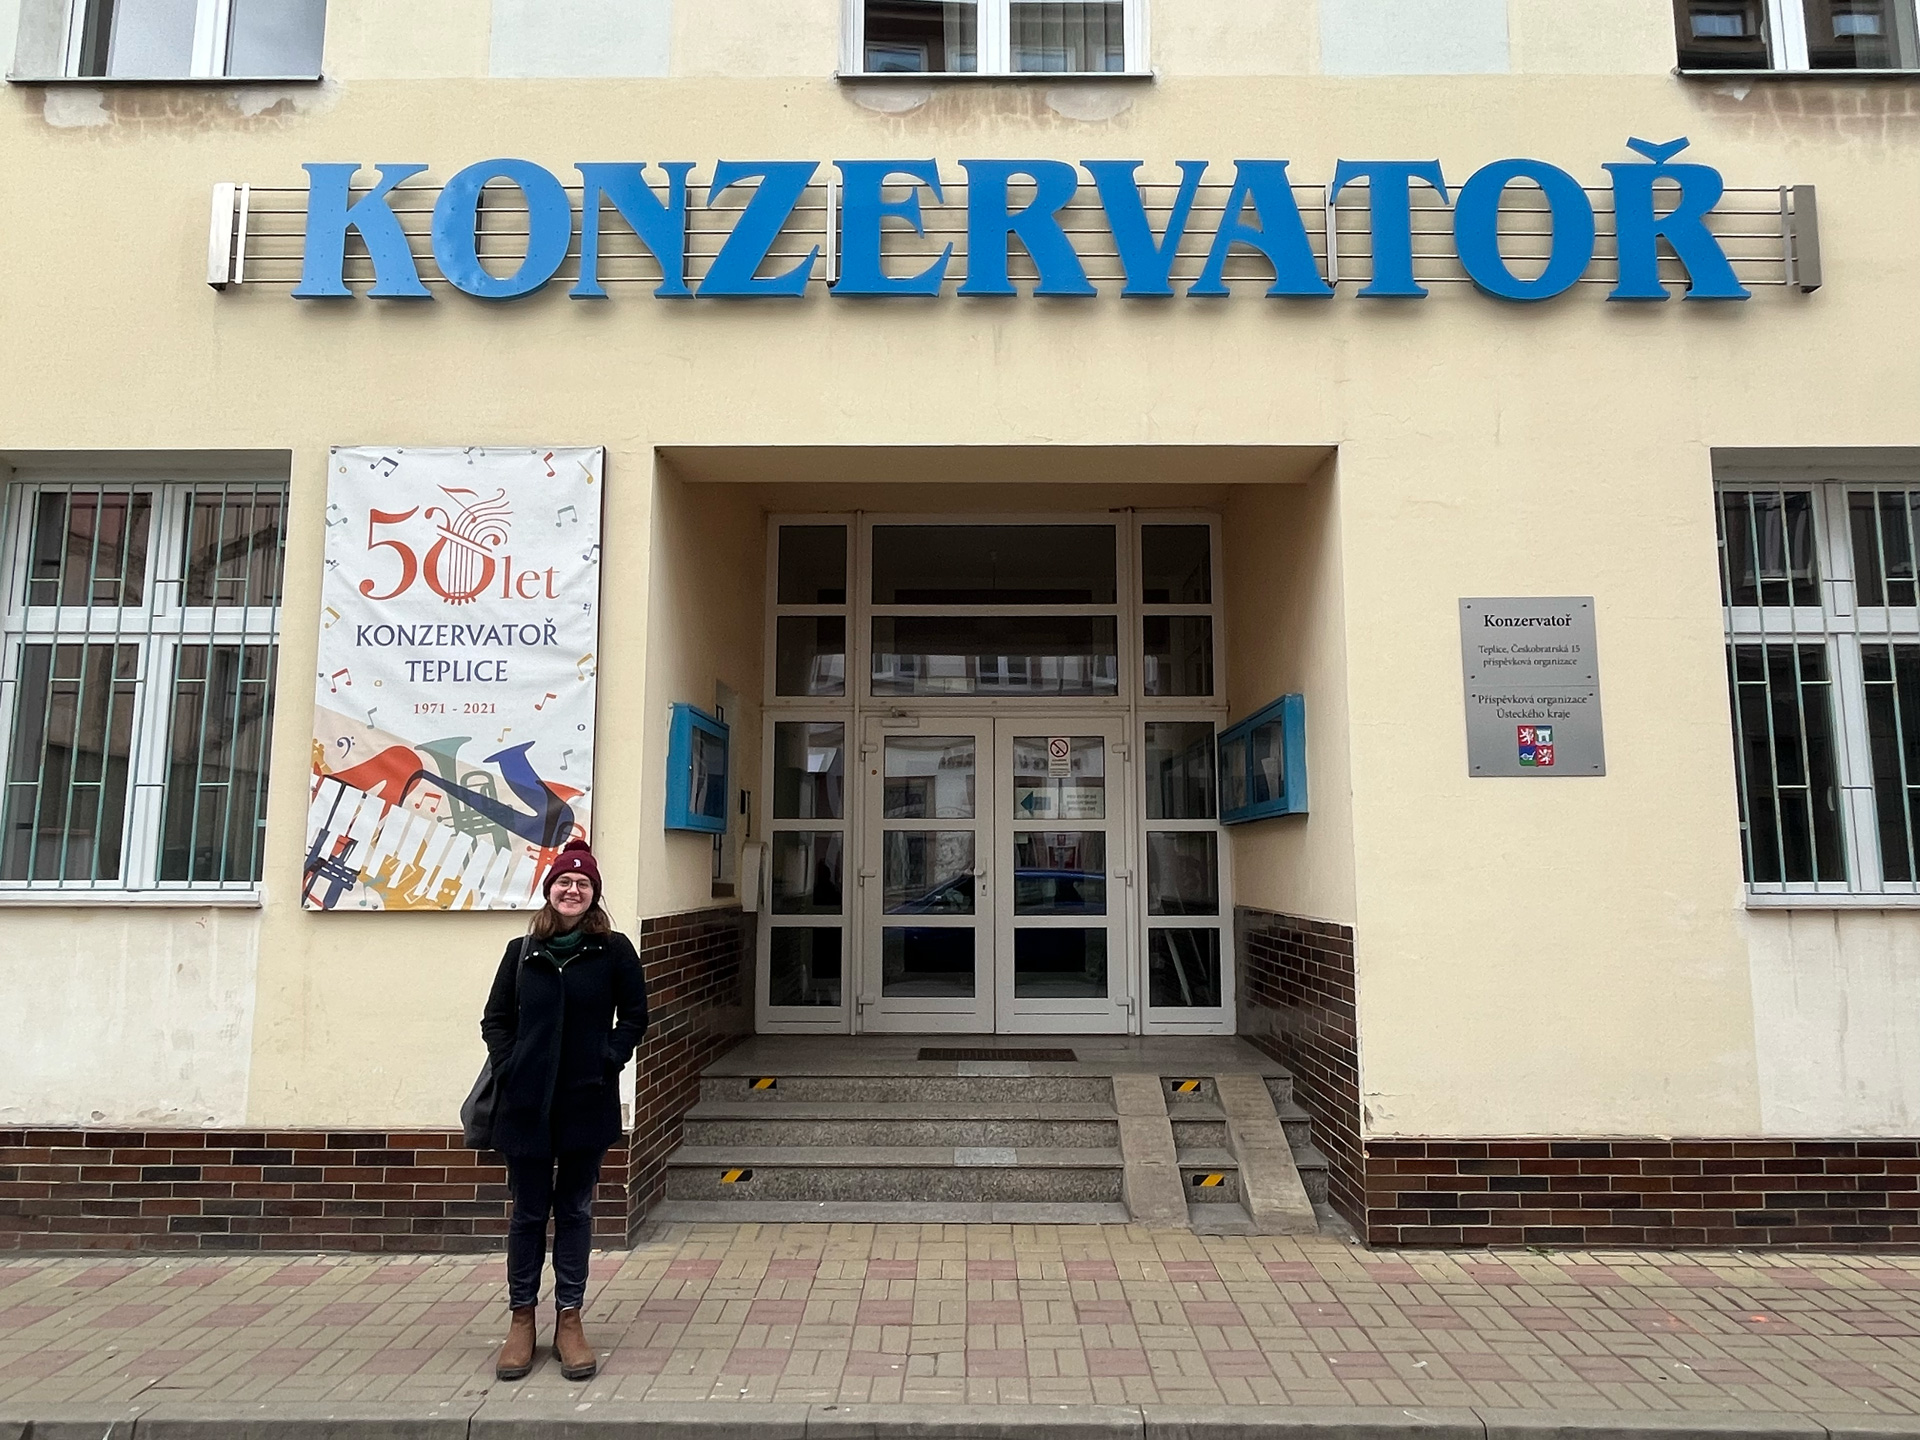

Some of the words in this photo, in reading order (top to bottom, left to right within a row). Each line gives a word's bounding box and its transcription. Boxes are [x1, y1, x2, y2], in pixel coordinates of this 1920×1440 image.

[290, 136, 1751, 308] KONZERVATOŘ
[359, 495, 505, 605] 50
[500, 555, 560, 600] let
[1483, 613, 1572, 627] Konzervatoř
[356, 618, 559, 647] KONZERVATOŘ
[1478, 645, 1509, 655] Teplice,
[1511, 643, 1569, 653] Českobratrská
[1571, 645, 1580, 653] 15
[1483, 657, 1532, 668] příspěvková
[1534, 658, 1577, 667] organizace
[405, 660, 508, 682] TEPLICE
[1478, 694, 1534, 706] Příspěvková
[1537, 695, 1587, 706] organizace
[414, 703, 446, 714] 1971
[463, 703, 496, 714] 2021
[1547, 708, 1571, 720] kraje
